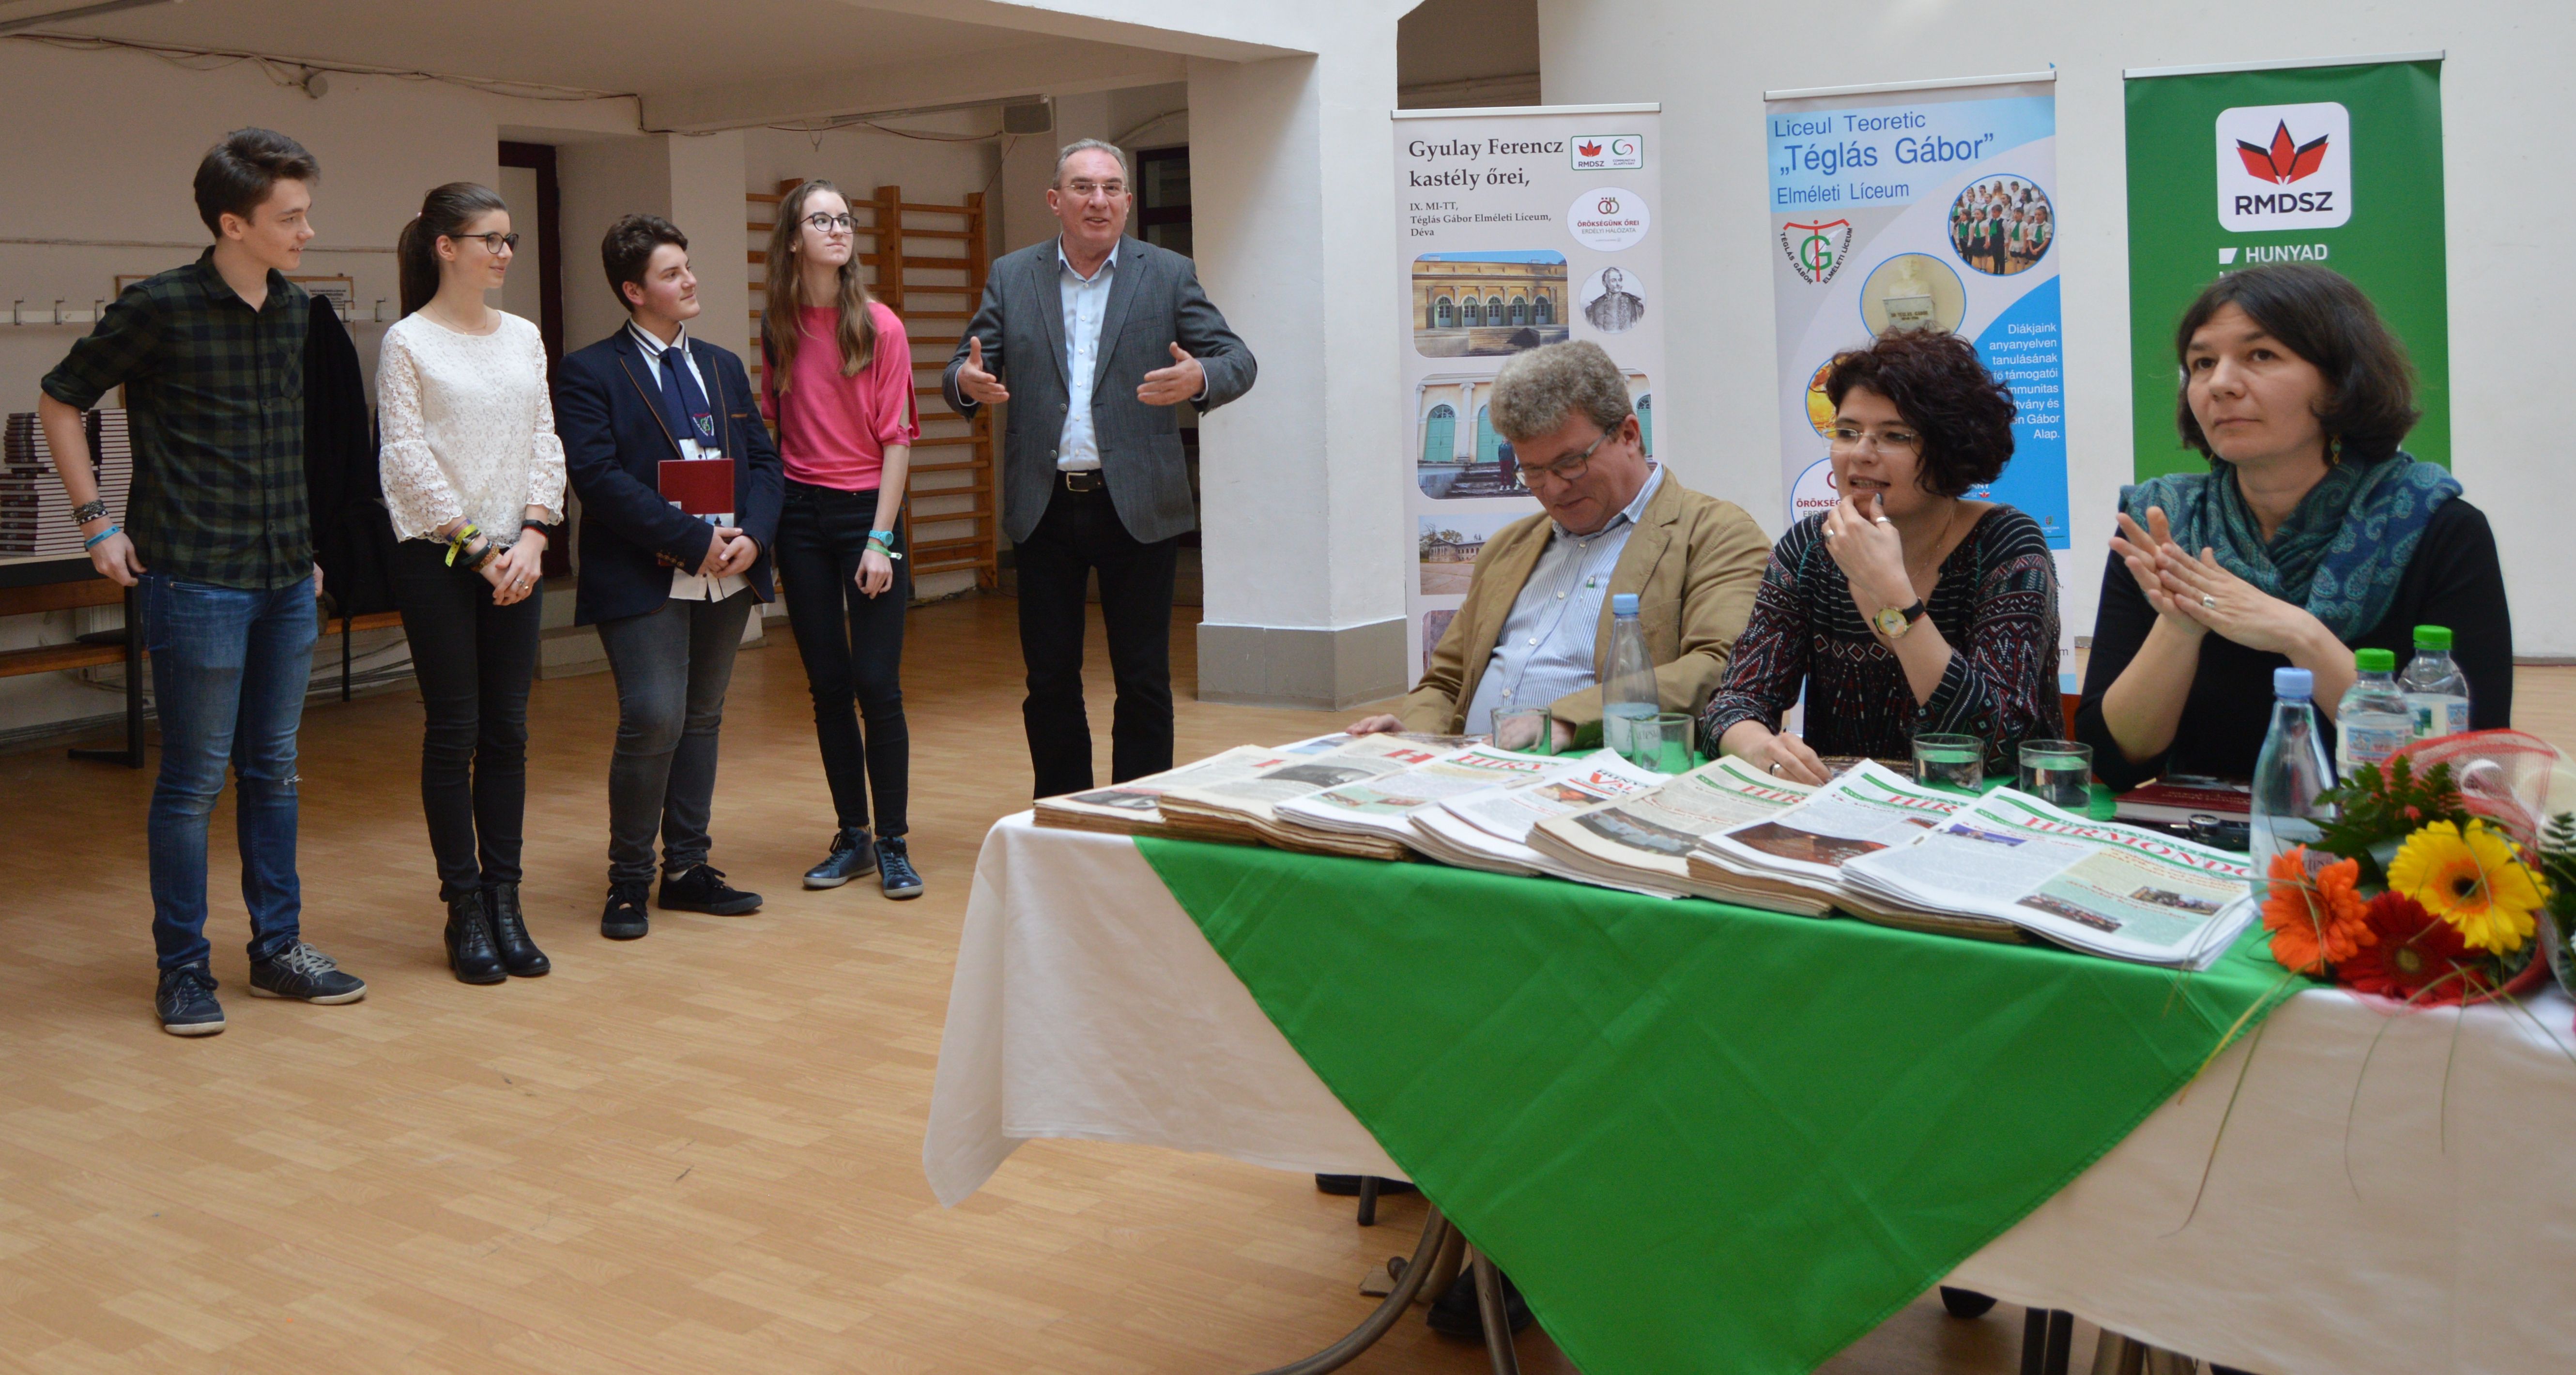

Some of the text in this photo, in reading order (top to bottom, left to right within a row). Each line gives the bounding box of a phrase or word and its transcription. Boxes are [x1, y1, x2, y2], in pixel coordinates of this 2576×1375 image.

[1775, 111, 1926, 137] Liceul Teoretic
[1409, 138, 1564, 162] Gyulay Ferencz
[1409, 168, 1530, 191] kastély őrei,
[1778, 182, 1909, 204] Elméleti Líceum
[1426, 202, 1458, 211] MI-TT,
[2235, 191, 2333, 216] RMDSZ
[1410, 213, 1551, 226] Téglás Gábor Elméleti Líceum,
[1411, 228, 1434, 237] Déva
[1780, 228, 1853, 285] TÉGLÁS GÁBOR ELMÉLETI LÍCEUM
[2245, 244, 2328, 263] HUNYAD
[2008, 323, 2056, 336] Diákjaink
[1989, 339, 2057, 352] anyanyelven
[1993, 353, 2057, 365] tanulásának
[2006, 368, 2058, 381] támogatói
[2008, 384, 2059, 394] mmunitas
[2047, 398, 2059, 408] és
[2027, 414, 2060, 424] Gábor
[2034, 429, 2060, 440] Alap.
[1796, 497, 1841, 507] ÖRÖKSÉG
